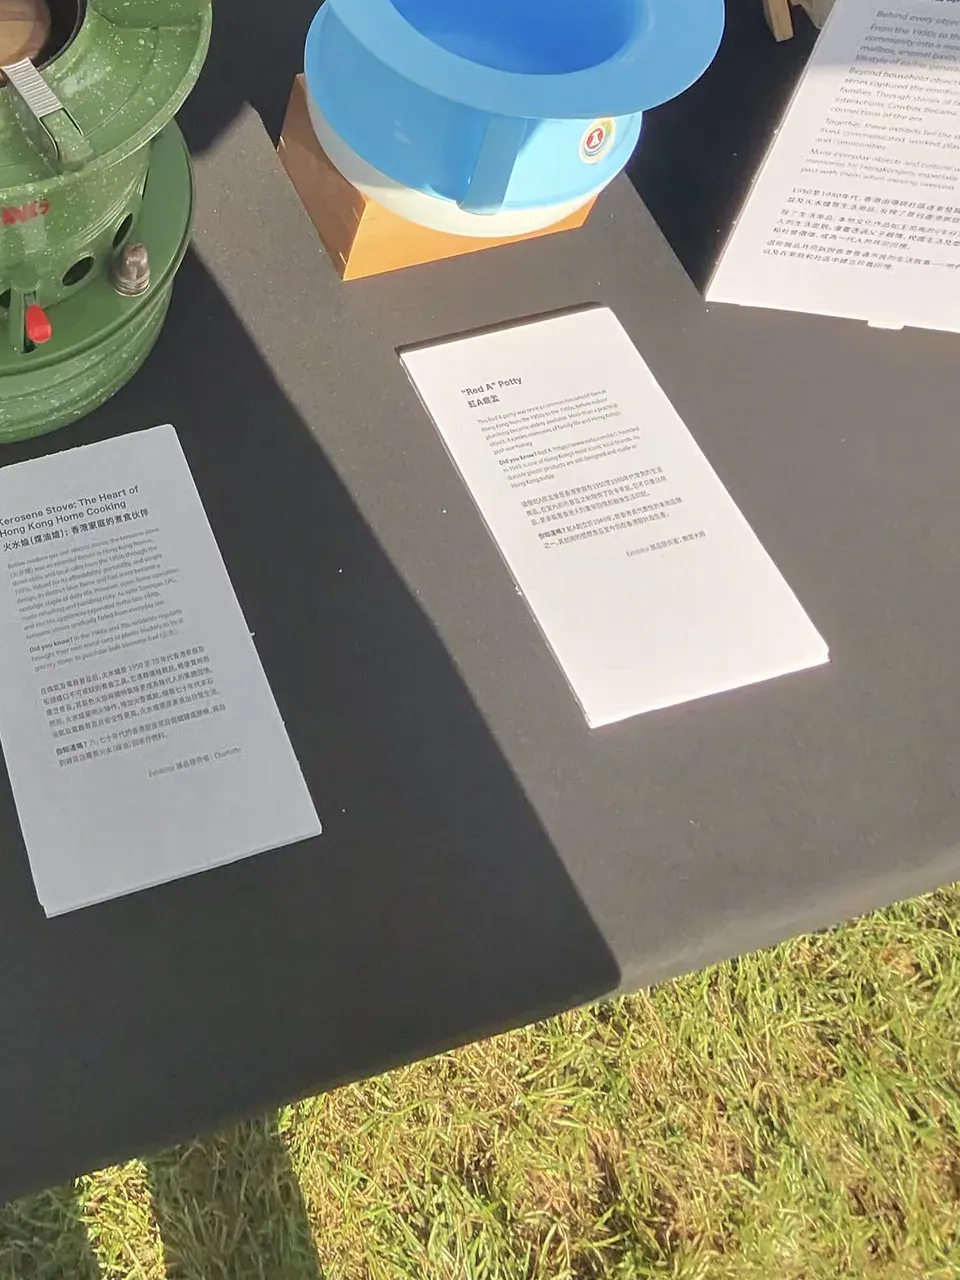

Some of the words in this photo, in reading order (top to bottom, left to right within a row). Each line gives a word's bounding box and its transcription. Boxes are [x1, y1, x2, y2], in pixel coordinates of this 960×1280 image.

[497, 377, 522, 388] Potty
[45, 502, 77, 515] Stove:
[77, 497, 97, 507] The
[98, 489, 127, 502] Heart
[129, 485, 139, 494] of
[0, 526, 26, 538] Hong
[27, 519, 54, 531] Kong
[55, 512, 84, 524] Home
[86, 501, 127, 516] Cooking
